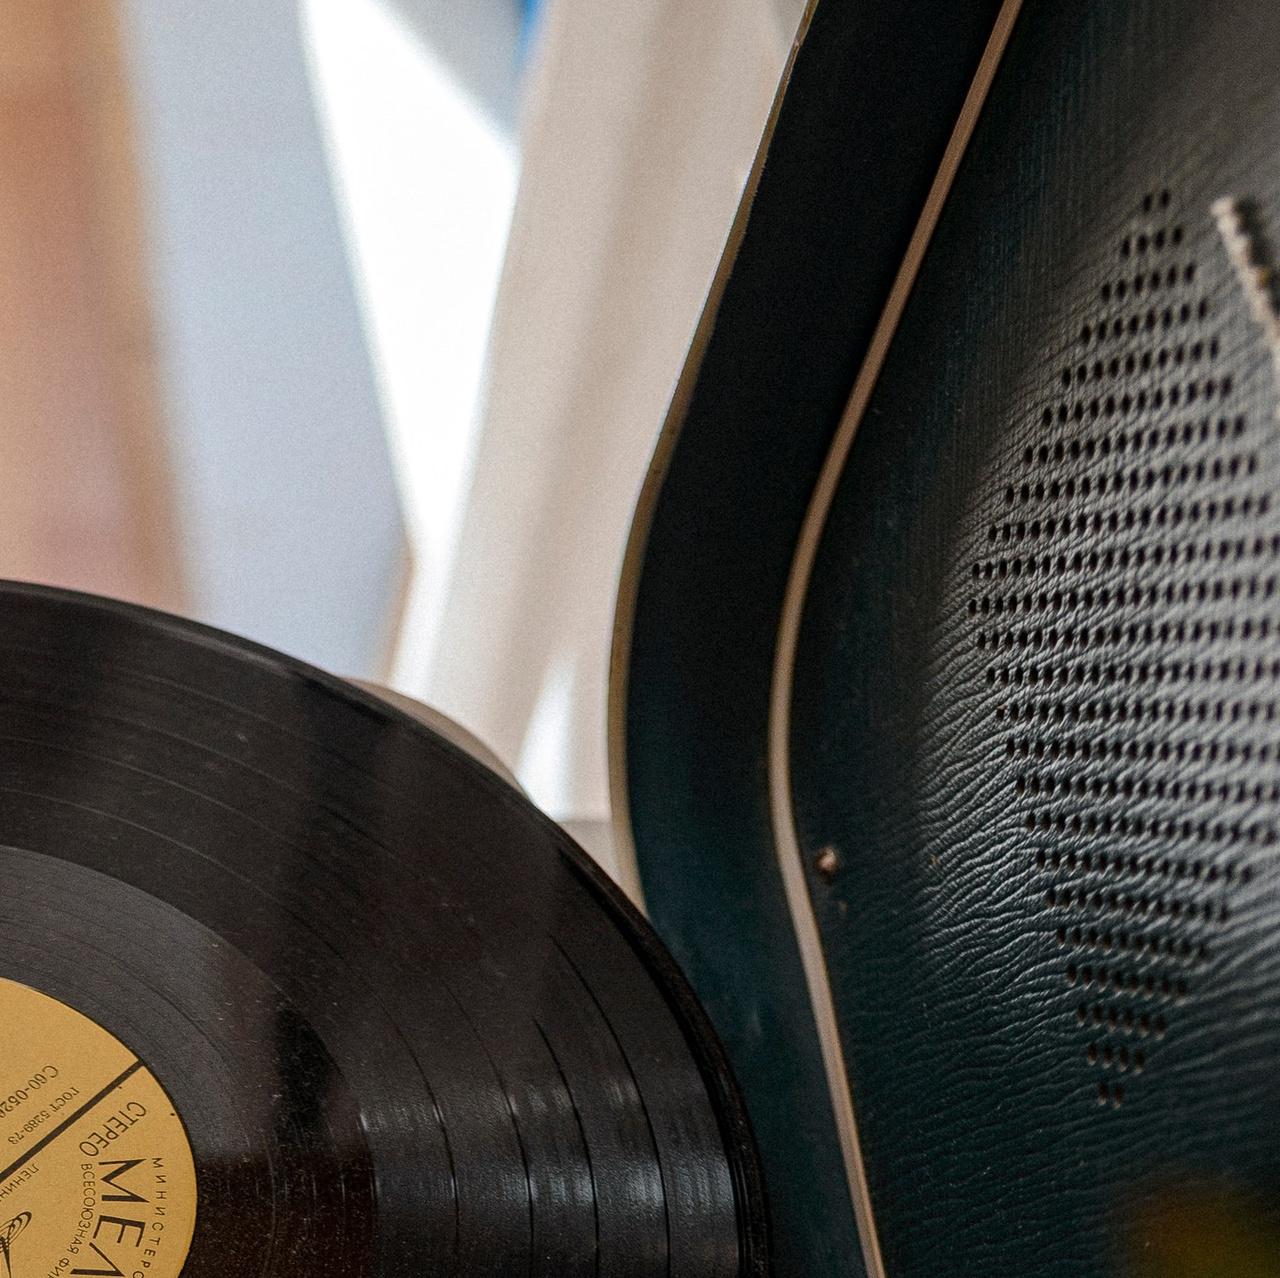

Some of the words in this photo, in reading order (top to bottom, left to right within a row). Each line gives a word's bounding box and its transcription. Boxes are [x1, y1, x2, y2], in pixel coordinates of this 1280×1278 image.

[47, 1085, 81, 1113] ГОСТ
[6, 1109, 52, 1145] 5289-73
[77, 1101, 148, 1159] СТЕРЕО
[65, 1162, 97, 1254] ВСЕСОЮЗНАЯ
